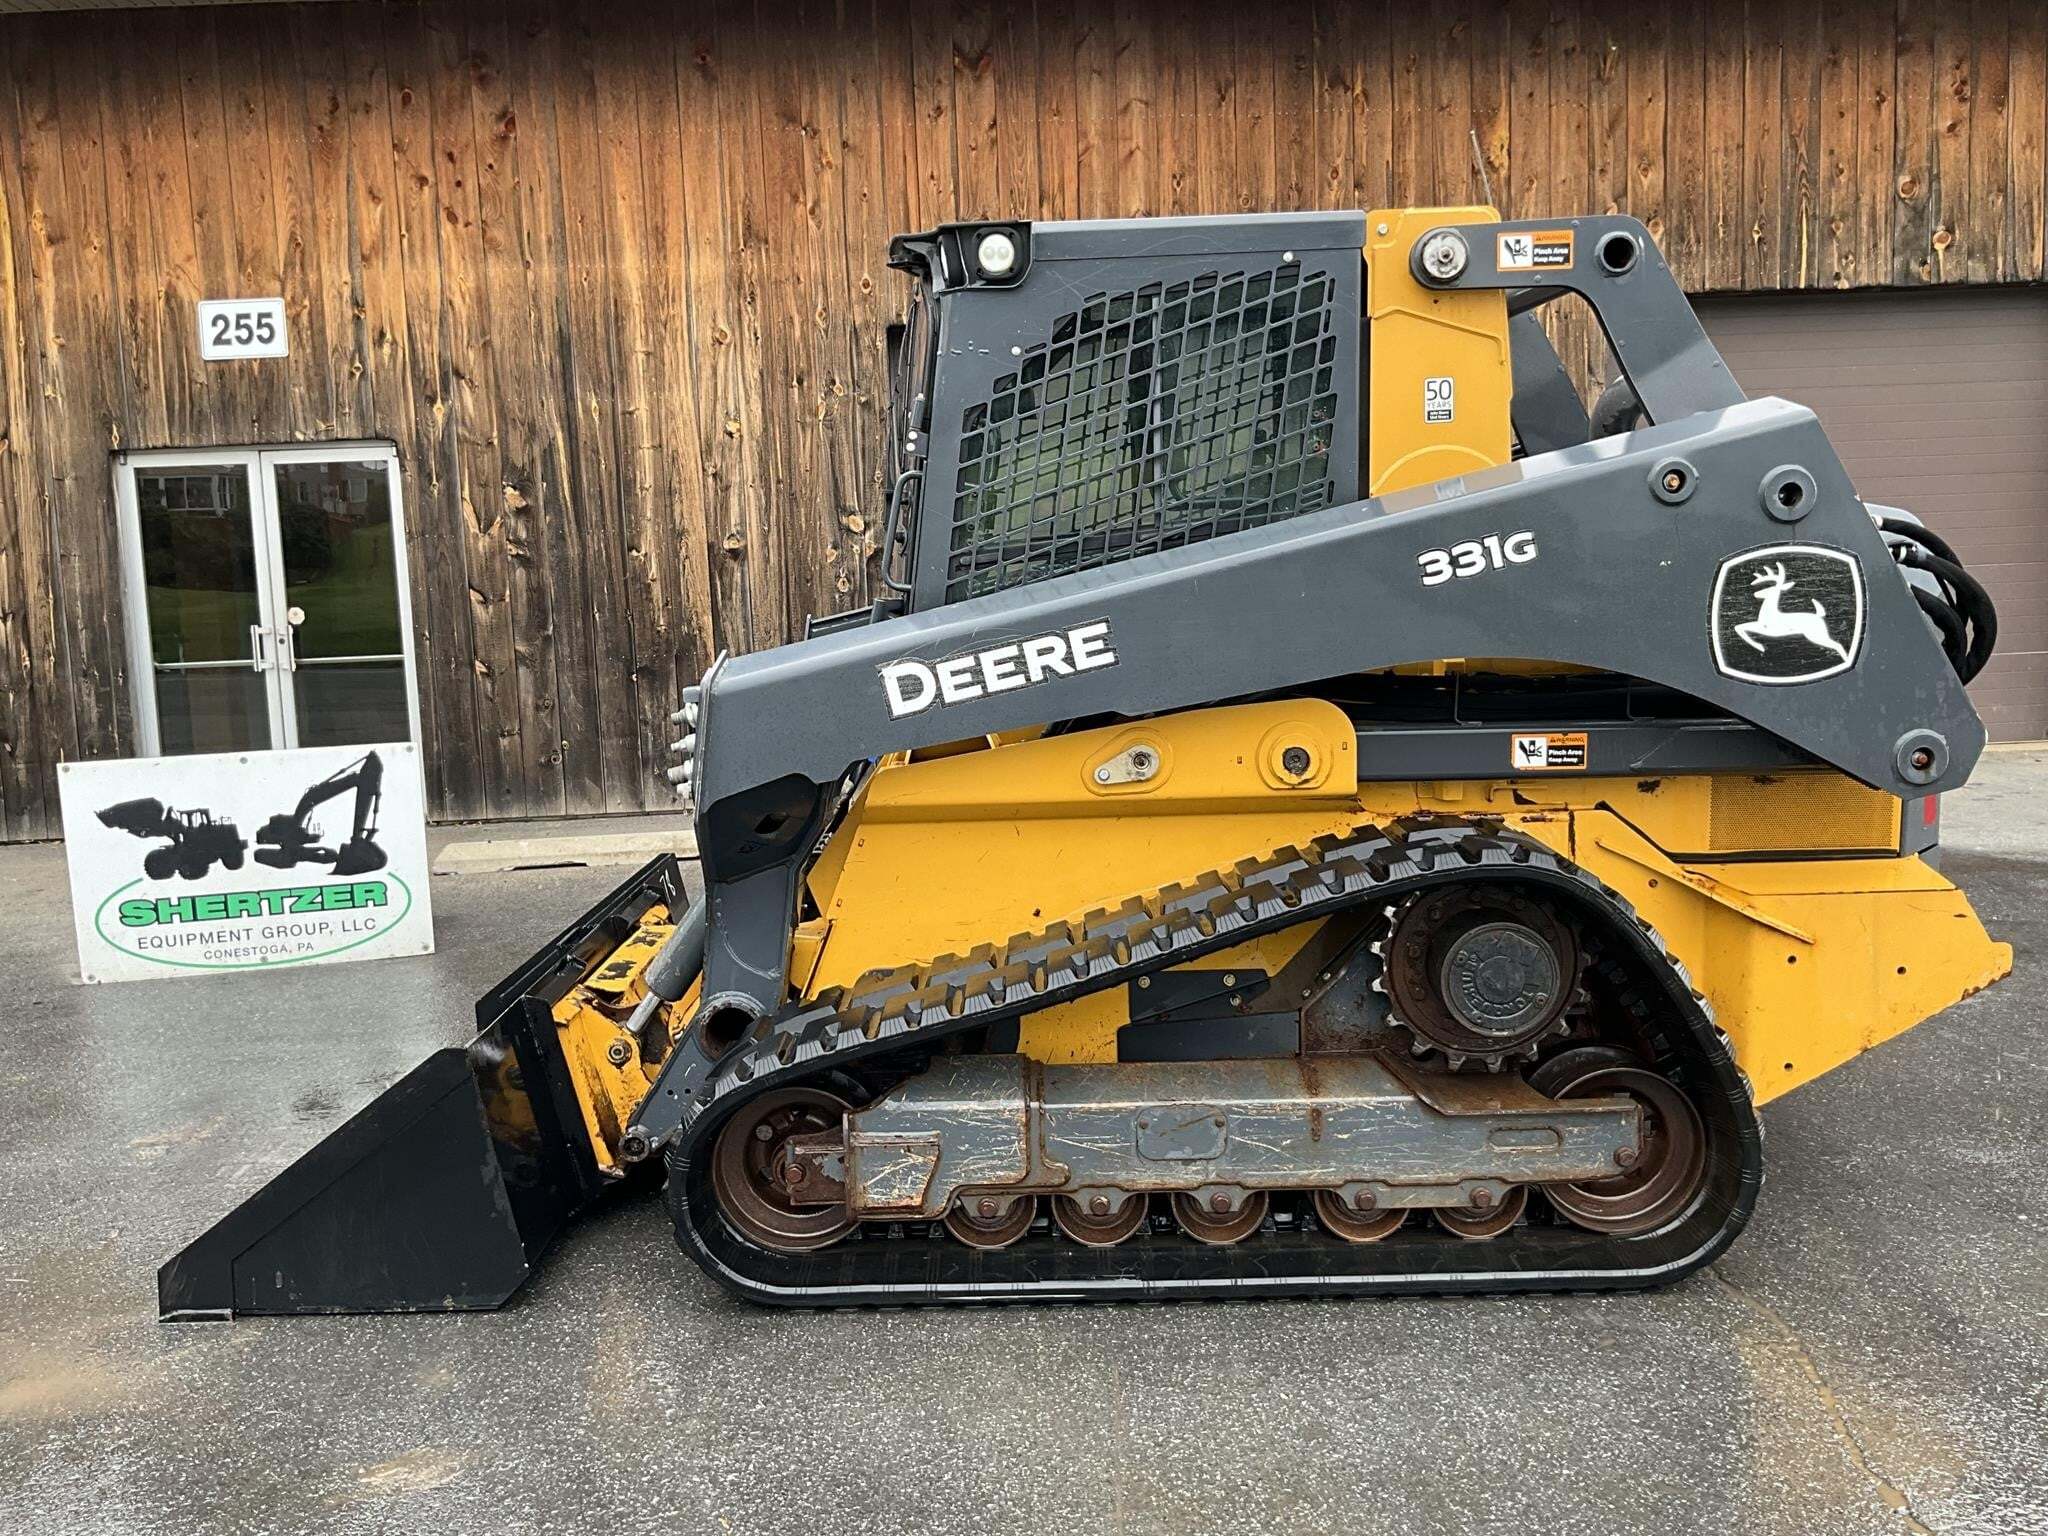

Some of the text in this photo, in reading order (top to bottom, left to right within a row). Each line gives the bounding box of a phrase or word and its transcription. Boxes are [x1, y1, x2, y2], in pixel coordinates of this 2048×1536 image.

[211, 312, 275, 346] 255
[1427, 380, 1452, 400] 50
[1417, 530, 1538, 586] 331G
[880, 622, 1116, 717] DEERE
[119, 881, 388, 927] SHERTZER
[138, 917, 377, 950] EQUIPMENT GROUP, LLC
[297, 942, 314, 952] PA
